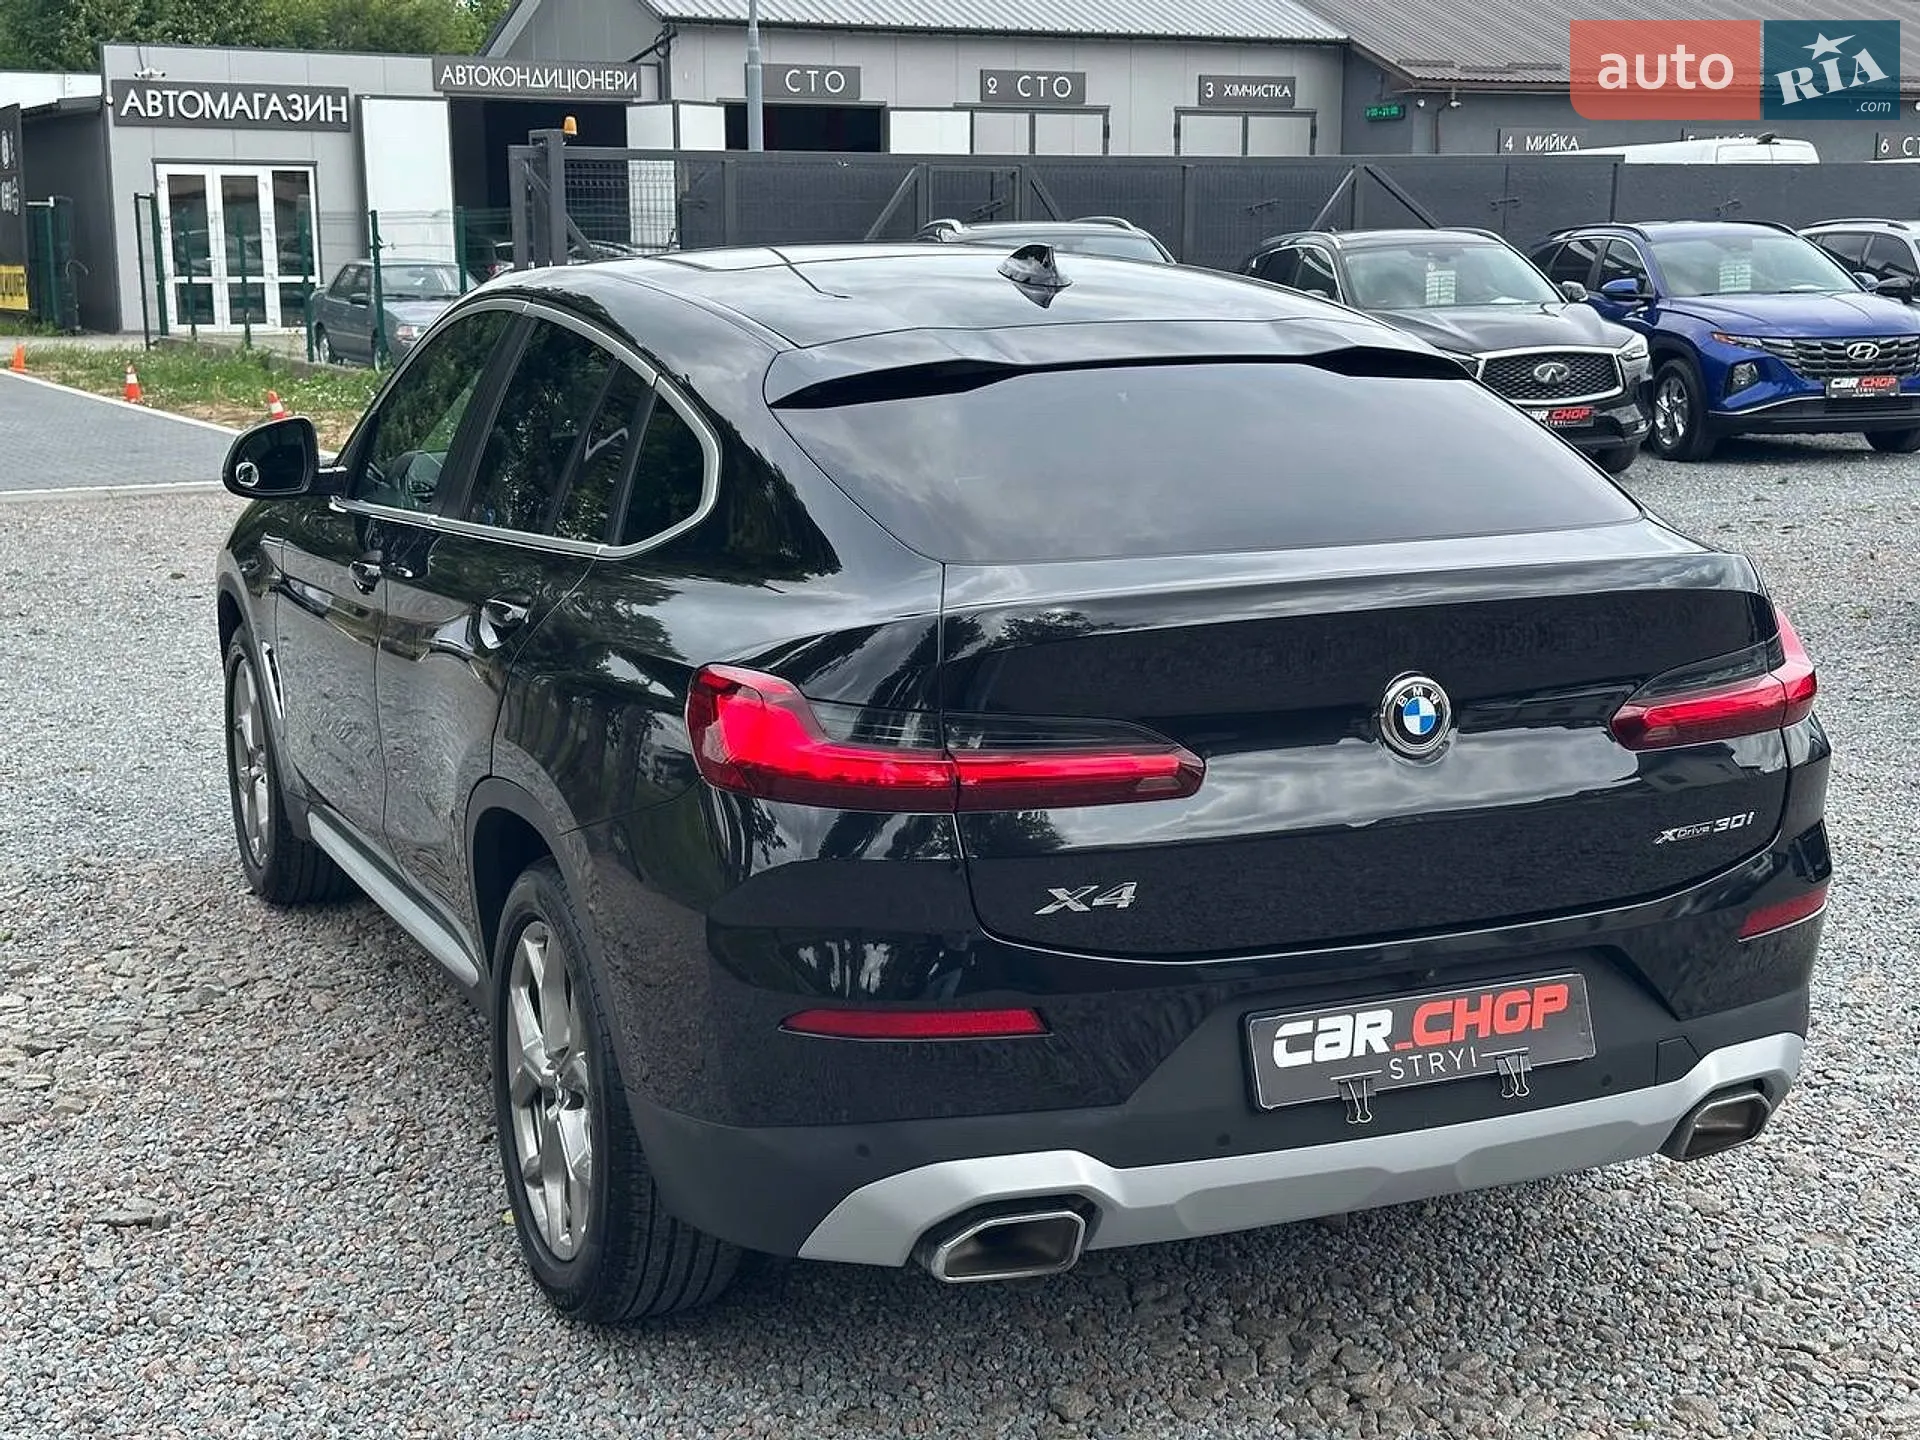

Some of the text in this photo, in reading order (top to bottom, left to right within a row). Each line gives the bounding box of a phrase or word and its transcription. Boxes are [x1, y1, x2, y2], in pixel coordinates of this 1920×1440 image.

[440, 64, 638, 92] АВТОКОНДИЦІОНЕРИ
[785, 69, 846, 93] СТО
[986, 74, 1073, 98] 2 СТО
[1205, 82, 1292, 98] 3 ХІМЧИСТКА
[120, 88, 348, 123] АВТОМАГАЗИН
[1505, 133, 1579, 151] 4 МИЙКА
[1881, 138, 1890, 153] 6
[1398, 686, 1439, 707] BMW
[1034, 882, 1137, 915] X4
[1389, 1046, 1477, 1080] STRYI
